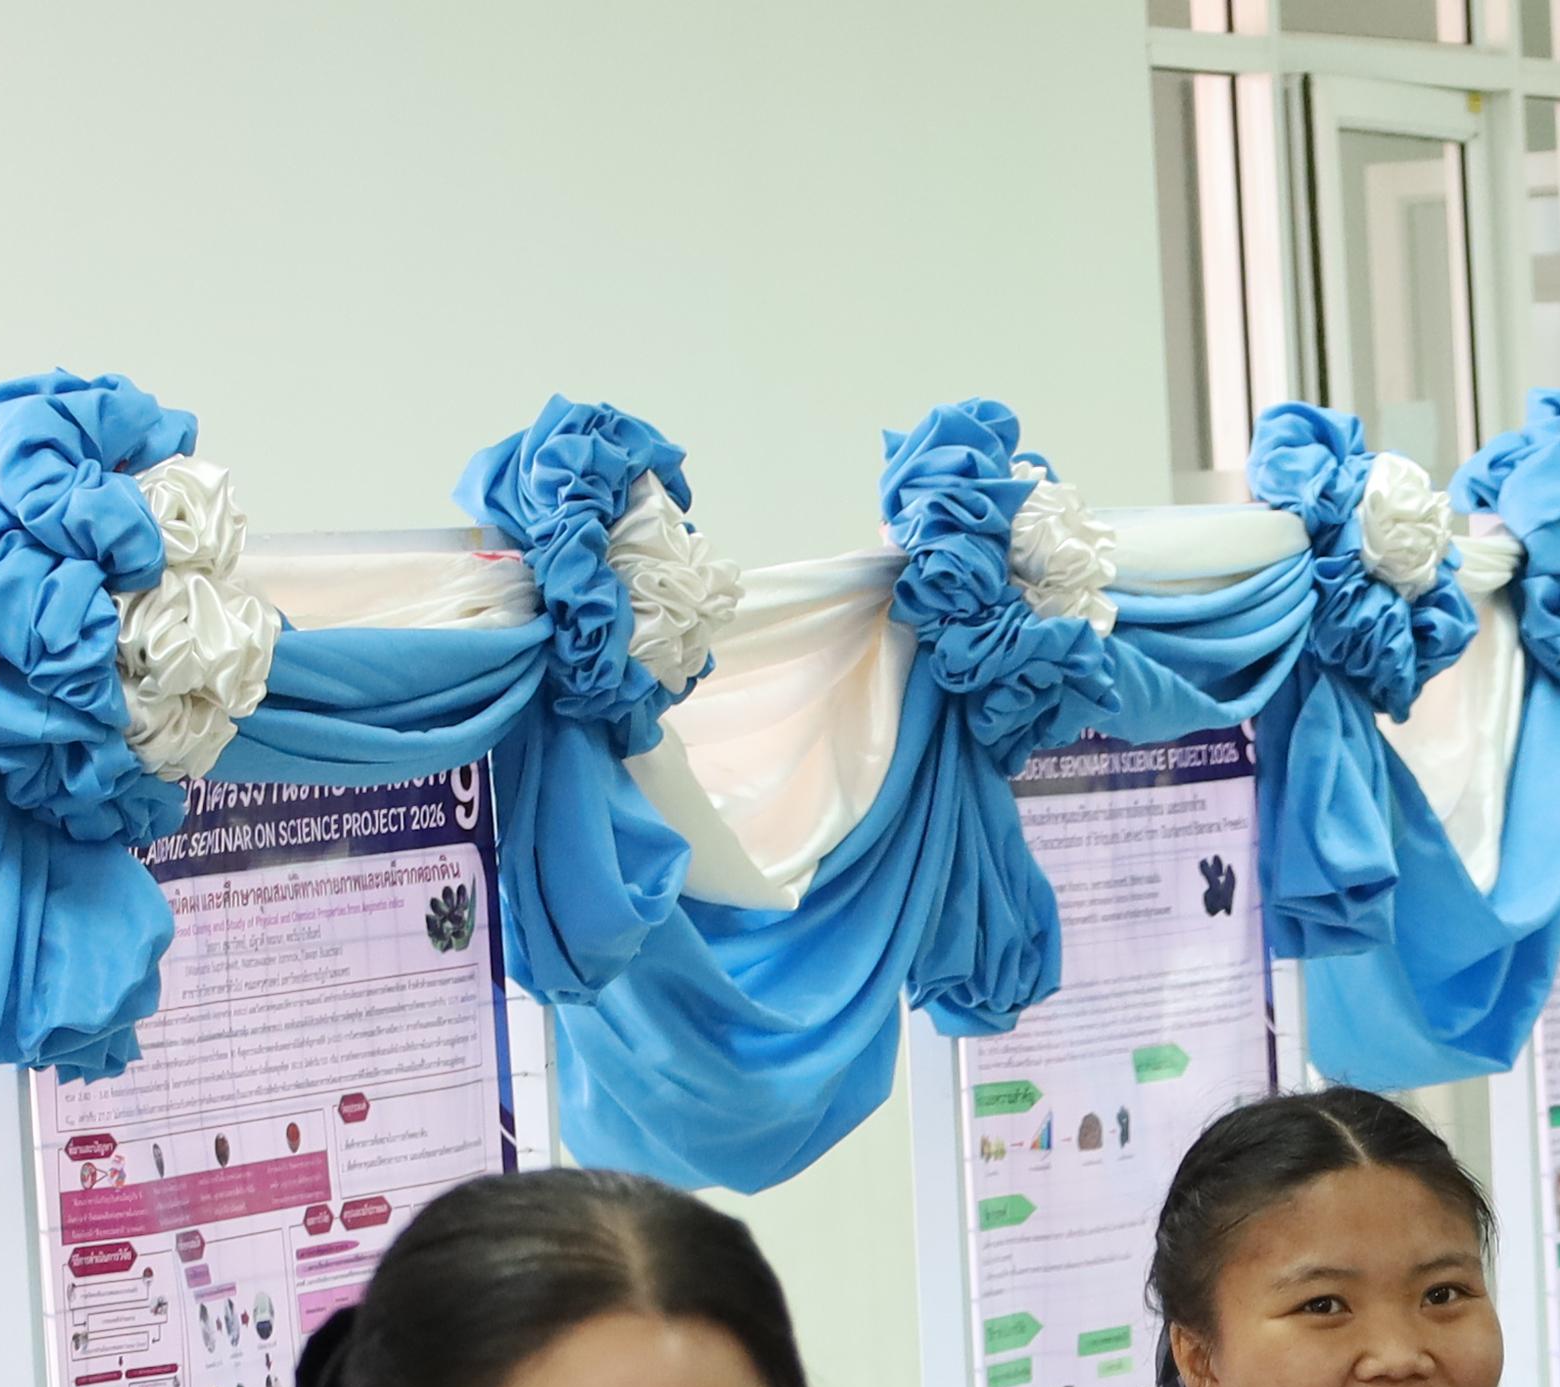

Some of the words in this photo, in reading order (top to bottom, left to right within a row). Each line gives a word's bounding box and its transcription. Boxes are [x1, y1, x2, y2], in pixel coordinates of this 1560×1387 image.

[1121, 747, 1167, 773] SCIENCE
[450, 762, 480, 831] 9
[188, 824, 253, 858] SEMINAR
[255, 822, 276, 849] ON
[278, 813, 340, 847] SCIENCE
[343, 807, 407, 839] PROJECT
[410, 802, 446, 831] 2026
